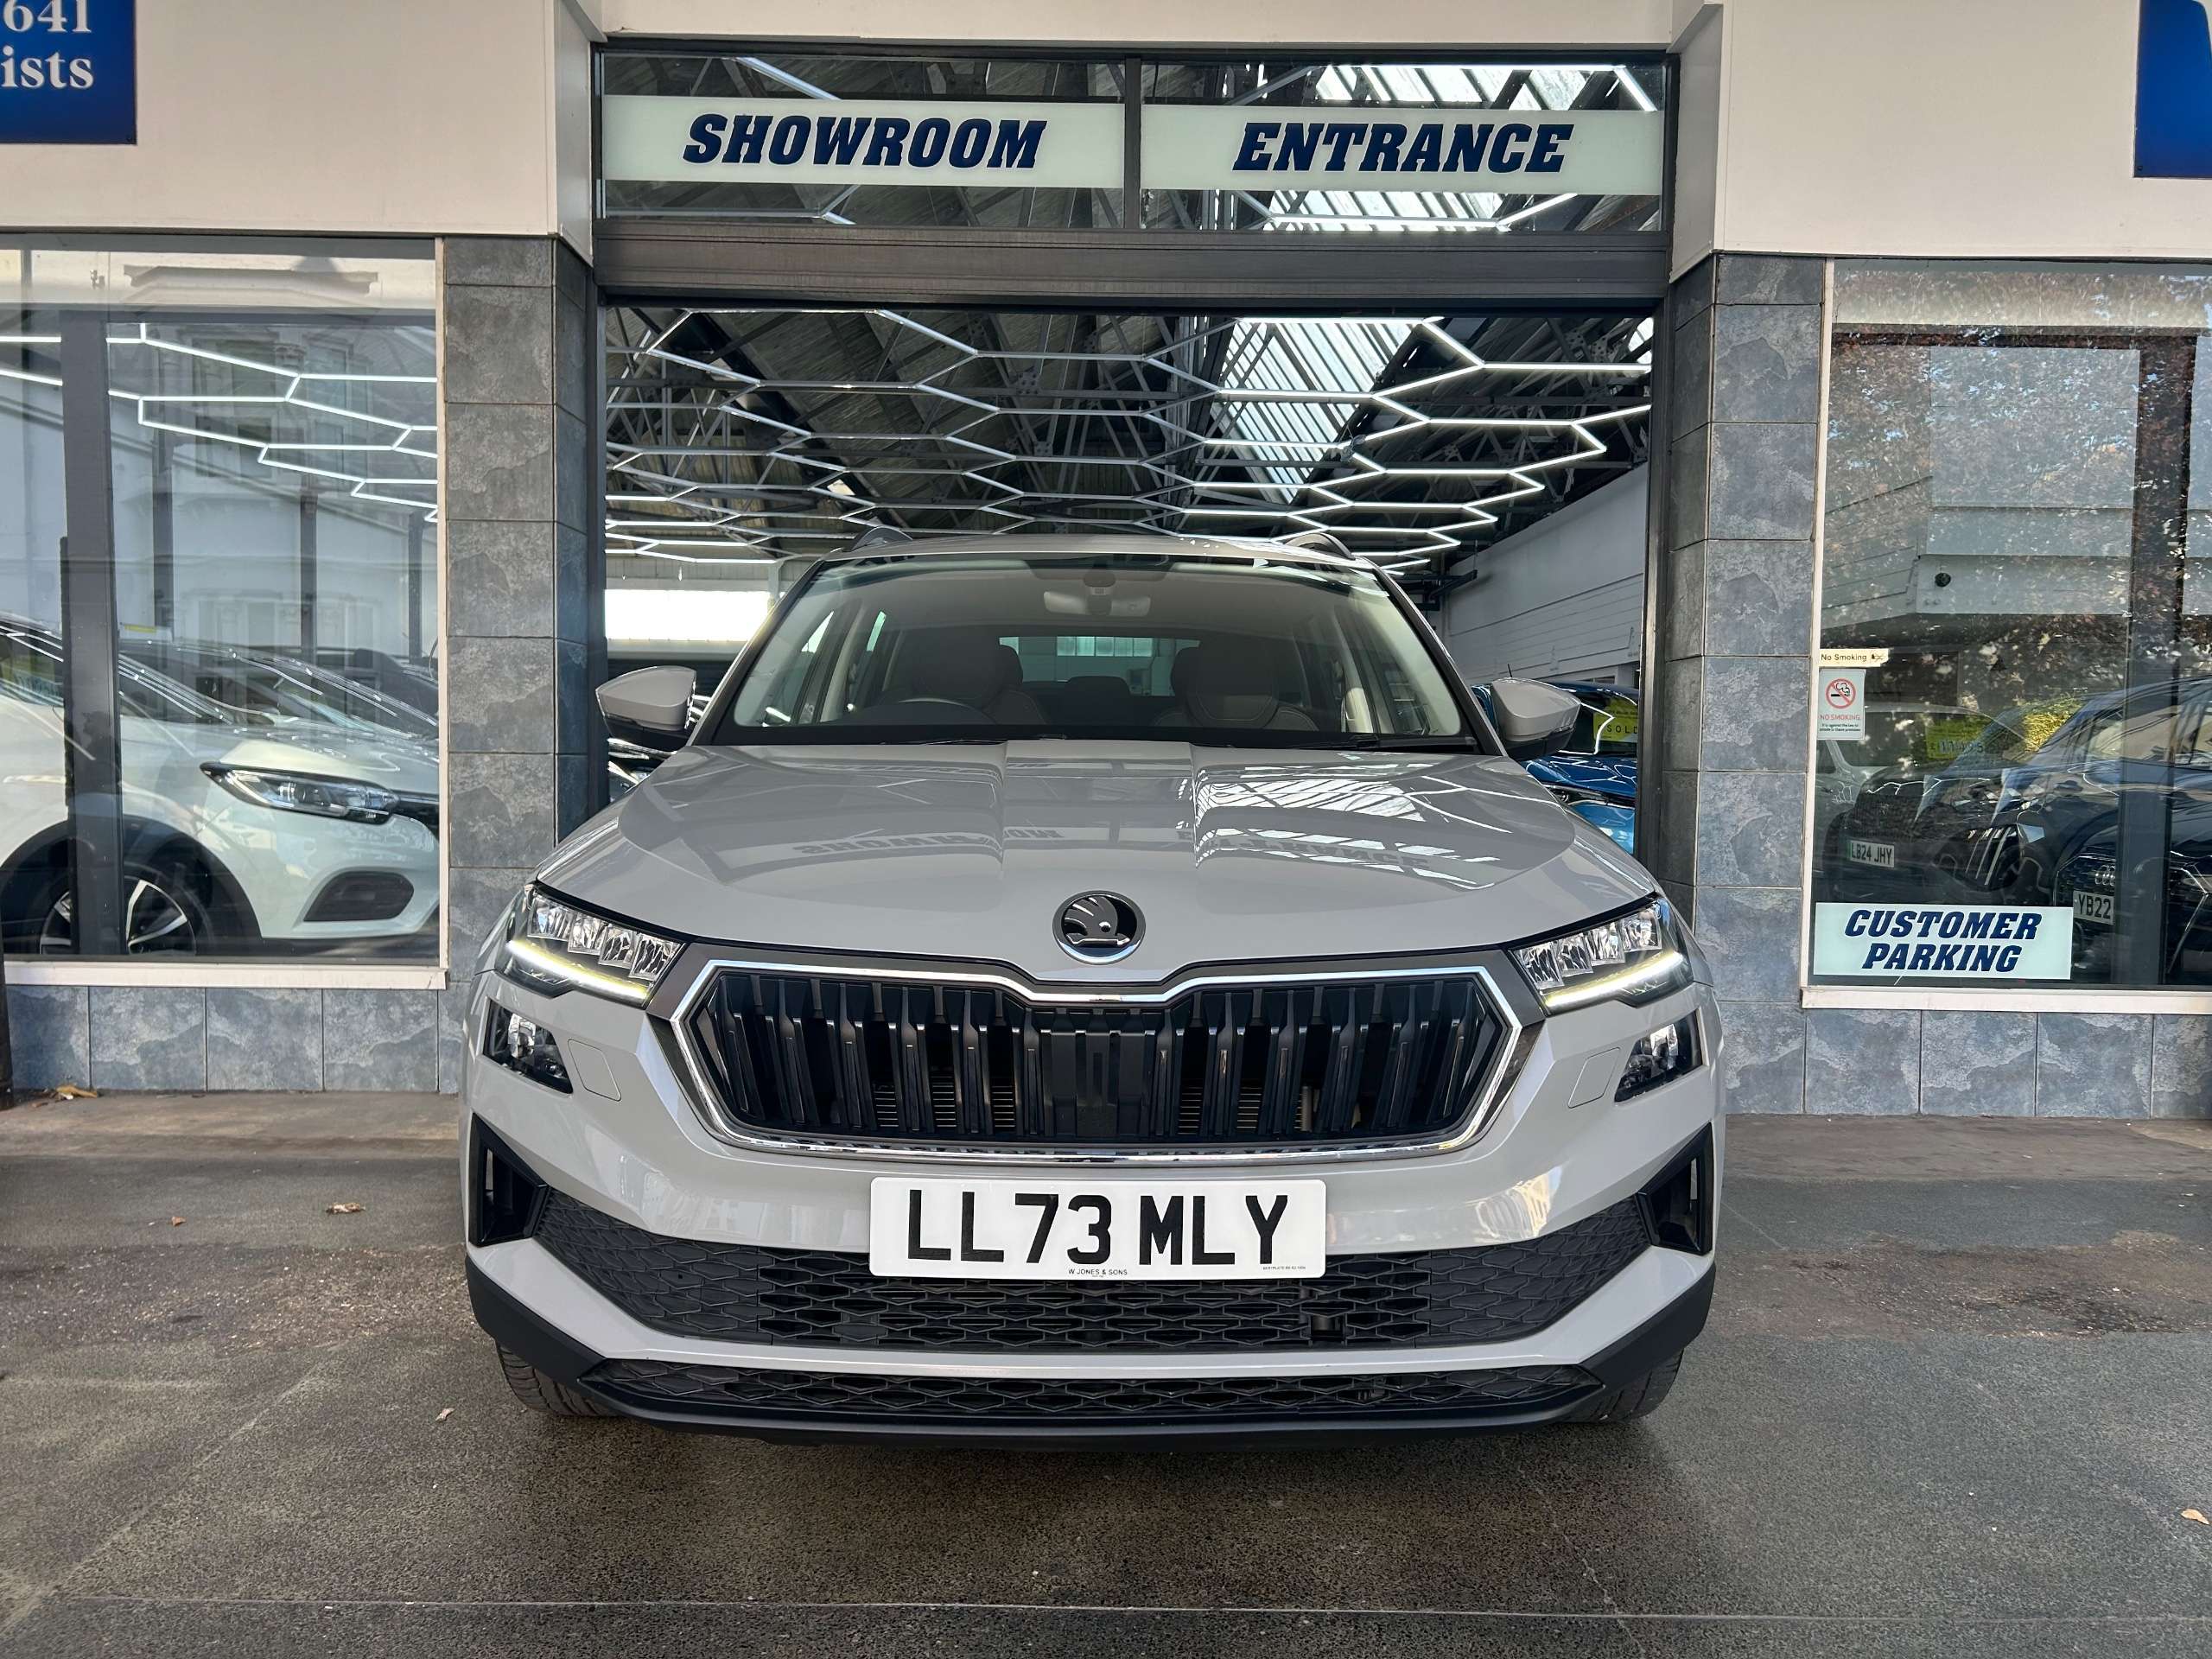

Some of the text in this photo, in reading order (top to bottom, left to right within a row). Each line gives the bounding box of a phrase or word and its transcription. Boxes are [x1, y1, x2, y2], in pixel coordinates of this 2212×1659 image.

[682, 113, 1573, 173] SHOWROOM ENTRANCE
[1834, 653, 1867, 662] Smoking
[1851, 843, 1892, 865] LB24 JHY
[2078, 893, 2111, 919] YB22
[1845, 910, 2043, 940] CUSTOMER
[1861, 943, 2023, 973] PARKING
[908, 1189, 1288, 1266] LL73 MLY
